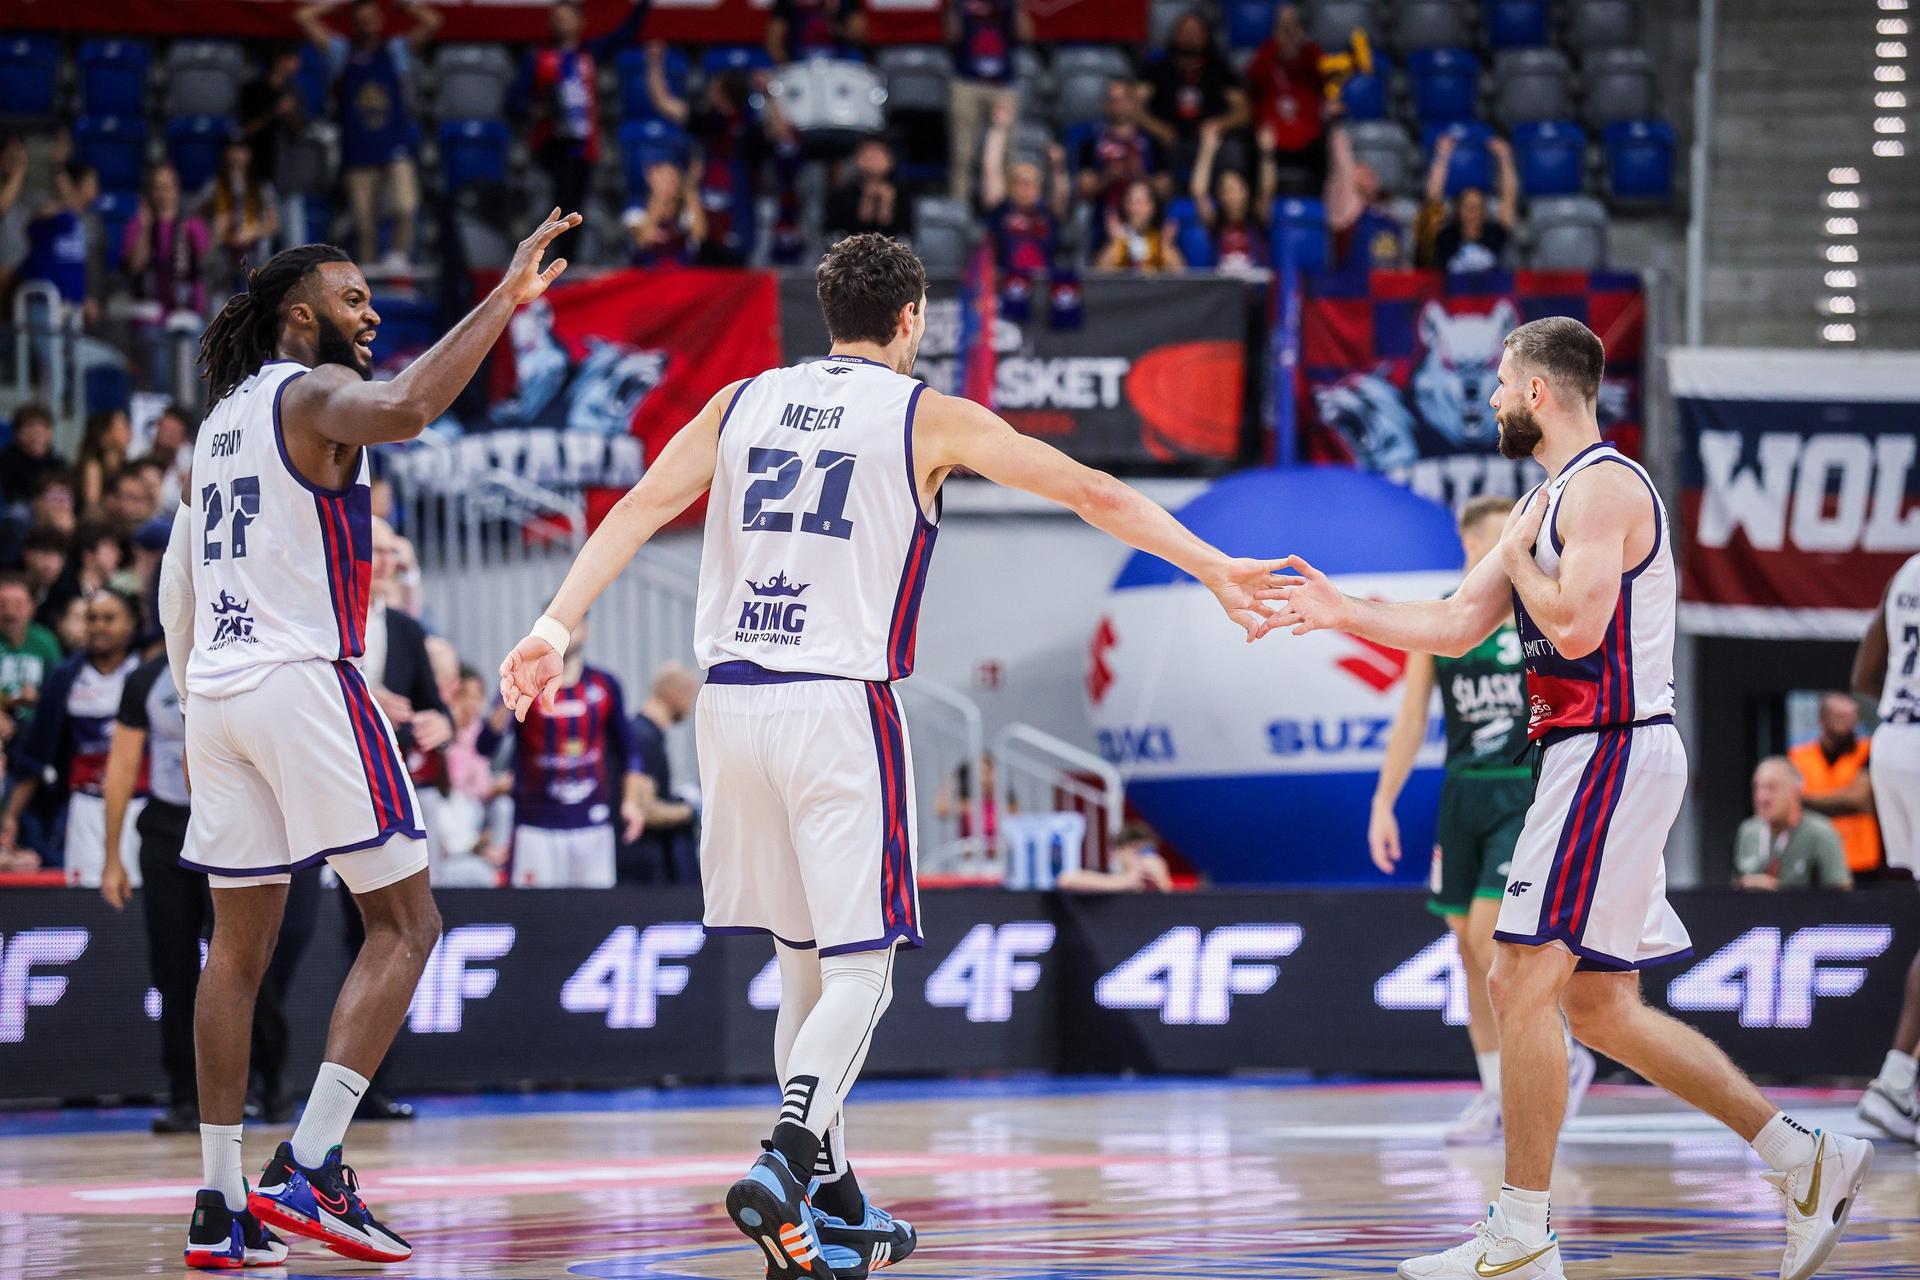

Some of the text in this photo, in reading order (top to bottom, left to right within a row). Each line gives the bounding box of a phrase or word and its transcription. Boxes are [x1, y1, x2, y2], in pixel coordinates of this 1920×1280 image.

[780, 403, 844, 432] MEIER
[742, 446, 857, 540] 21
[738, 601, 807, 633] KING
[1507, 880, 1533, 897] 4F
[0, 926, 91, 1043] F
[560, 923, 706, 1029] 4F
[925, 921, 1056, 1022] 4F
[1094, 922, 1302, 1025] 4F
[1375, 931, 1471, 1026] 4
[1667, 924, 1894, 1029] 4F
